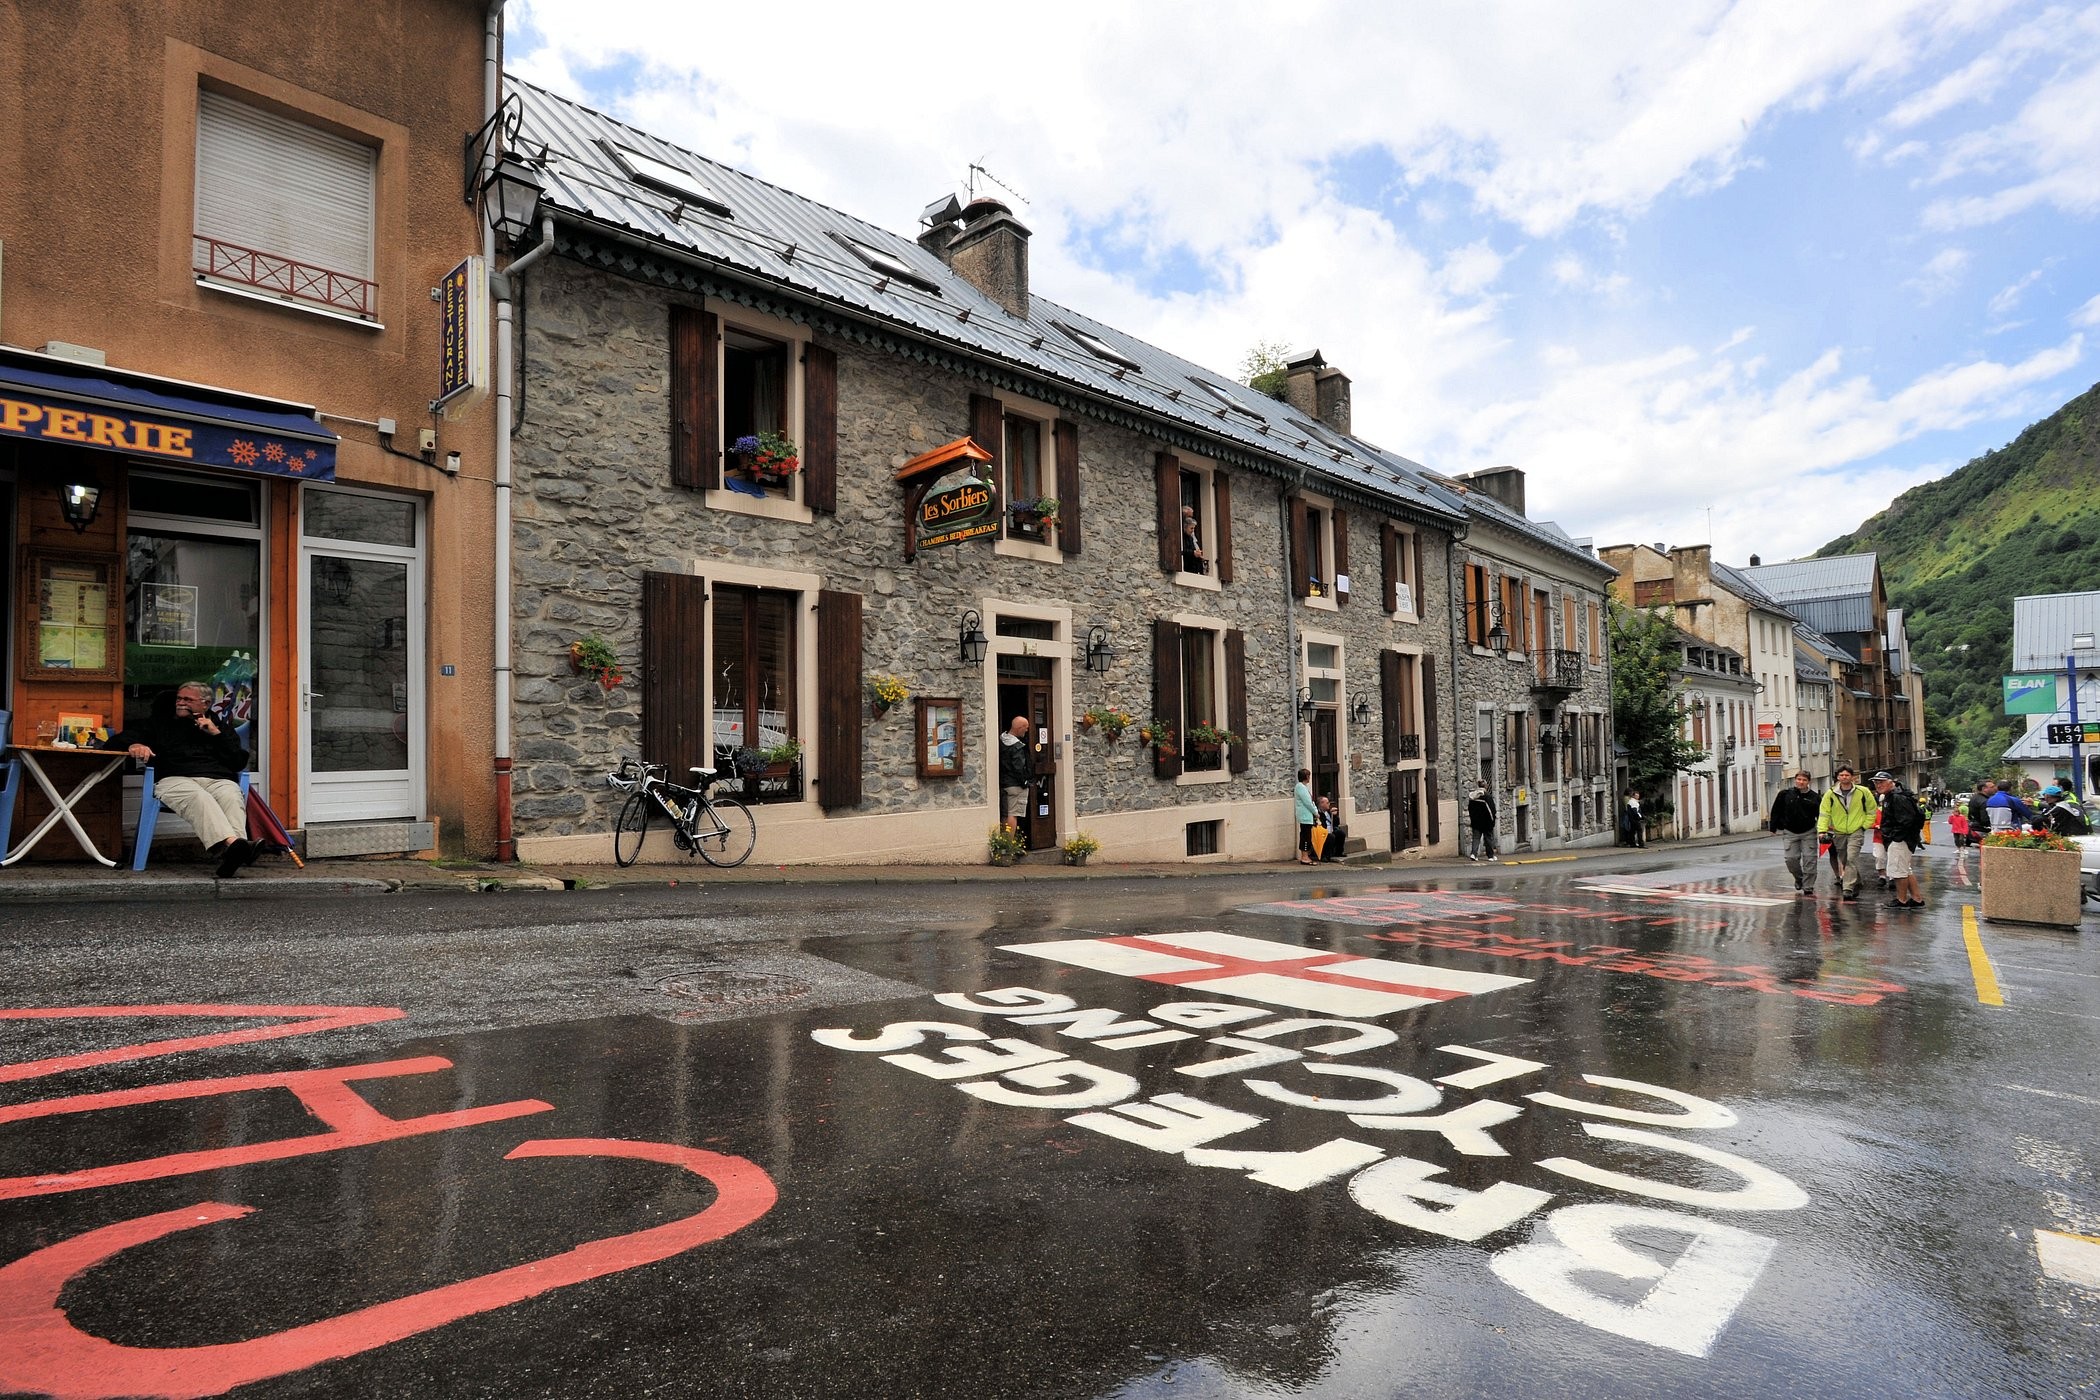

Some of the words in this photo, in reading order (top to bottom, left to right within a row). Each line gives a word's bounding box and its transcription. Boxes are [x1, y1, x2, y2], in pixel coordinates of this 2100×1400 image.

[446, 279, 455, 392] RESTAURANT
[457, 291, 465, 385] CREPERIE
[923, 502, 939, 521] Les
[941, 487, 989, 516] Sorbiers
[964, 522, 998, 538] BREAKFAST
[2052, 725, 2081, 734] 1.54
[2053, 734, 2082, 743] 1.37
[1148, 1002, 1740, 1130] CLUB
[934, 987, 1812, 1213] CYCLING
